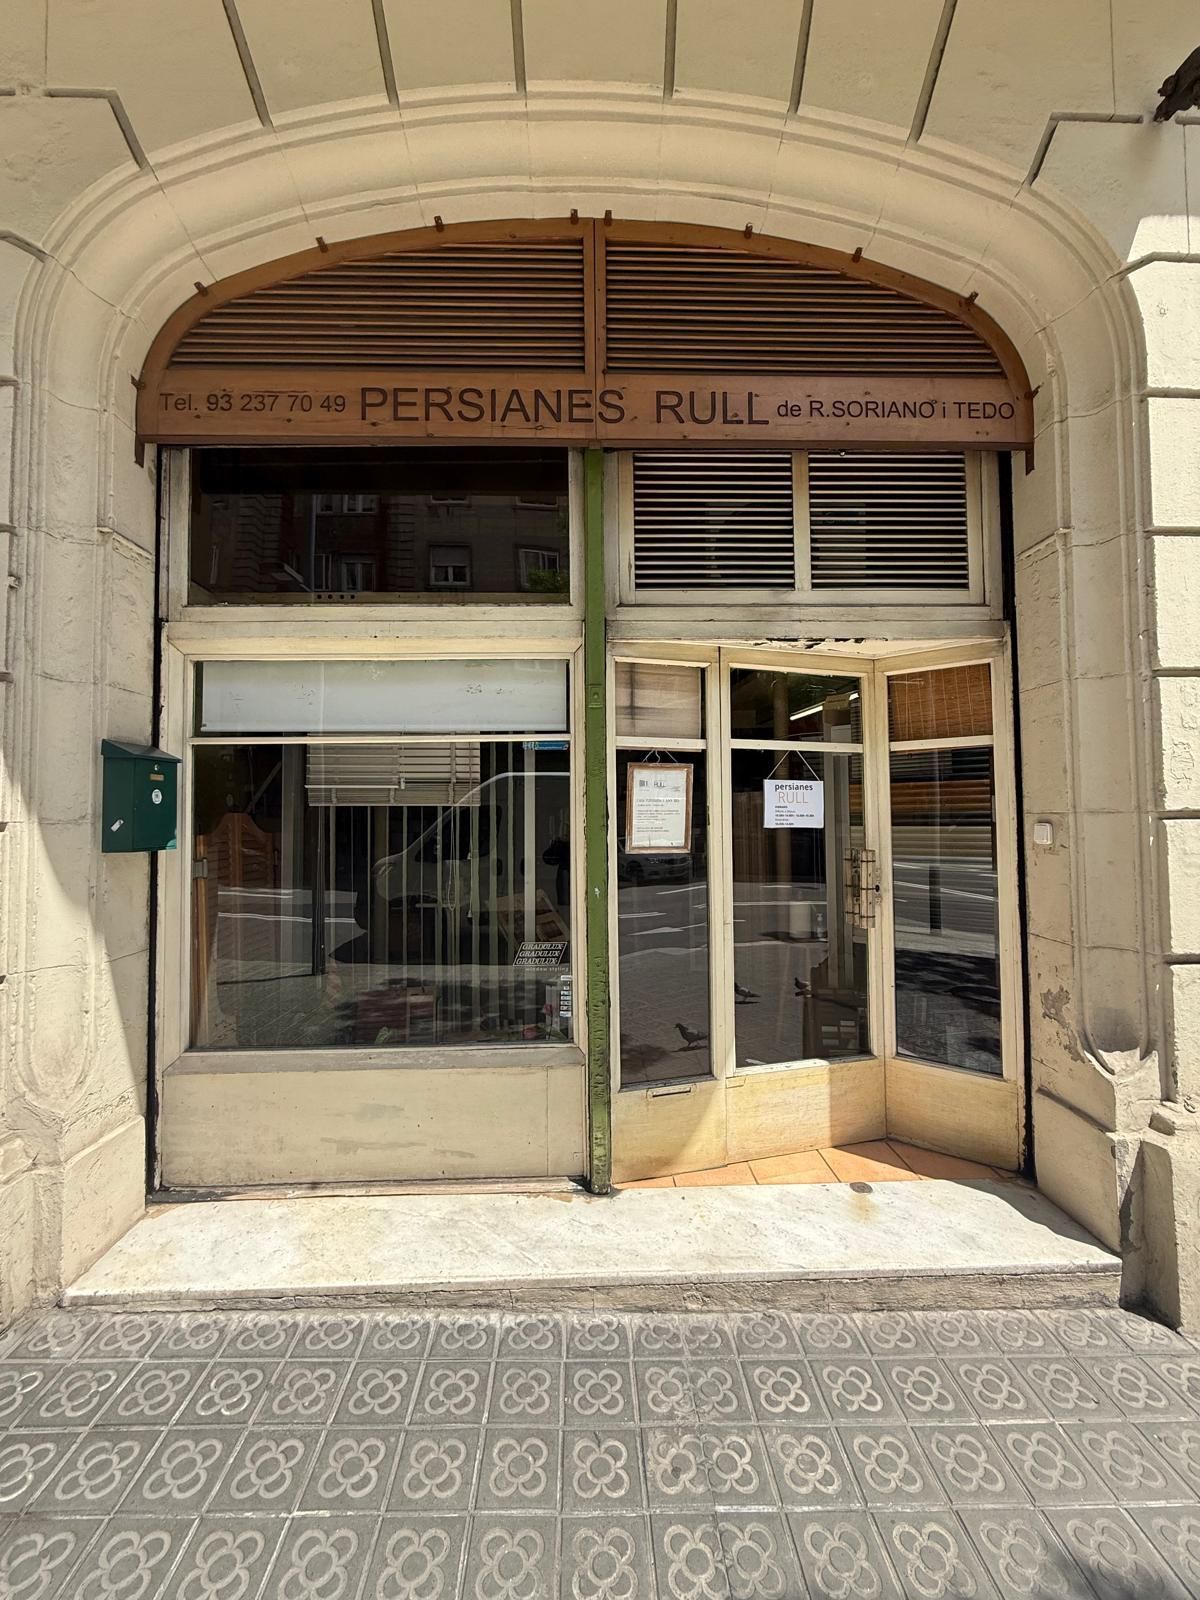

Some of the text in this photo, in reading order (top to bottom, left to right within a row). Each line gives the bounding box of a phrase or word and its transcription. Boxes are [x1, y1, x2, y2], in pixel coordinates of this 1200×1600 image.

[159, 386, 1016, 425] Tel. 93 237 70 49 PERSIANES RULL de R.SORIANO i TEDO
[774, 782, 814, 792] persianes
[778, 791, 809, 804] RULL
[516, 957, 557, 965] GRADULUX
